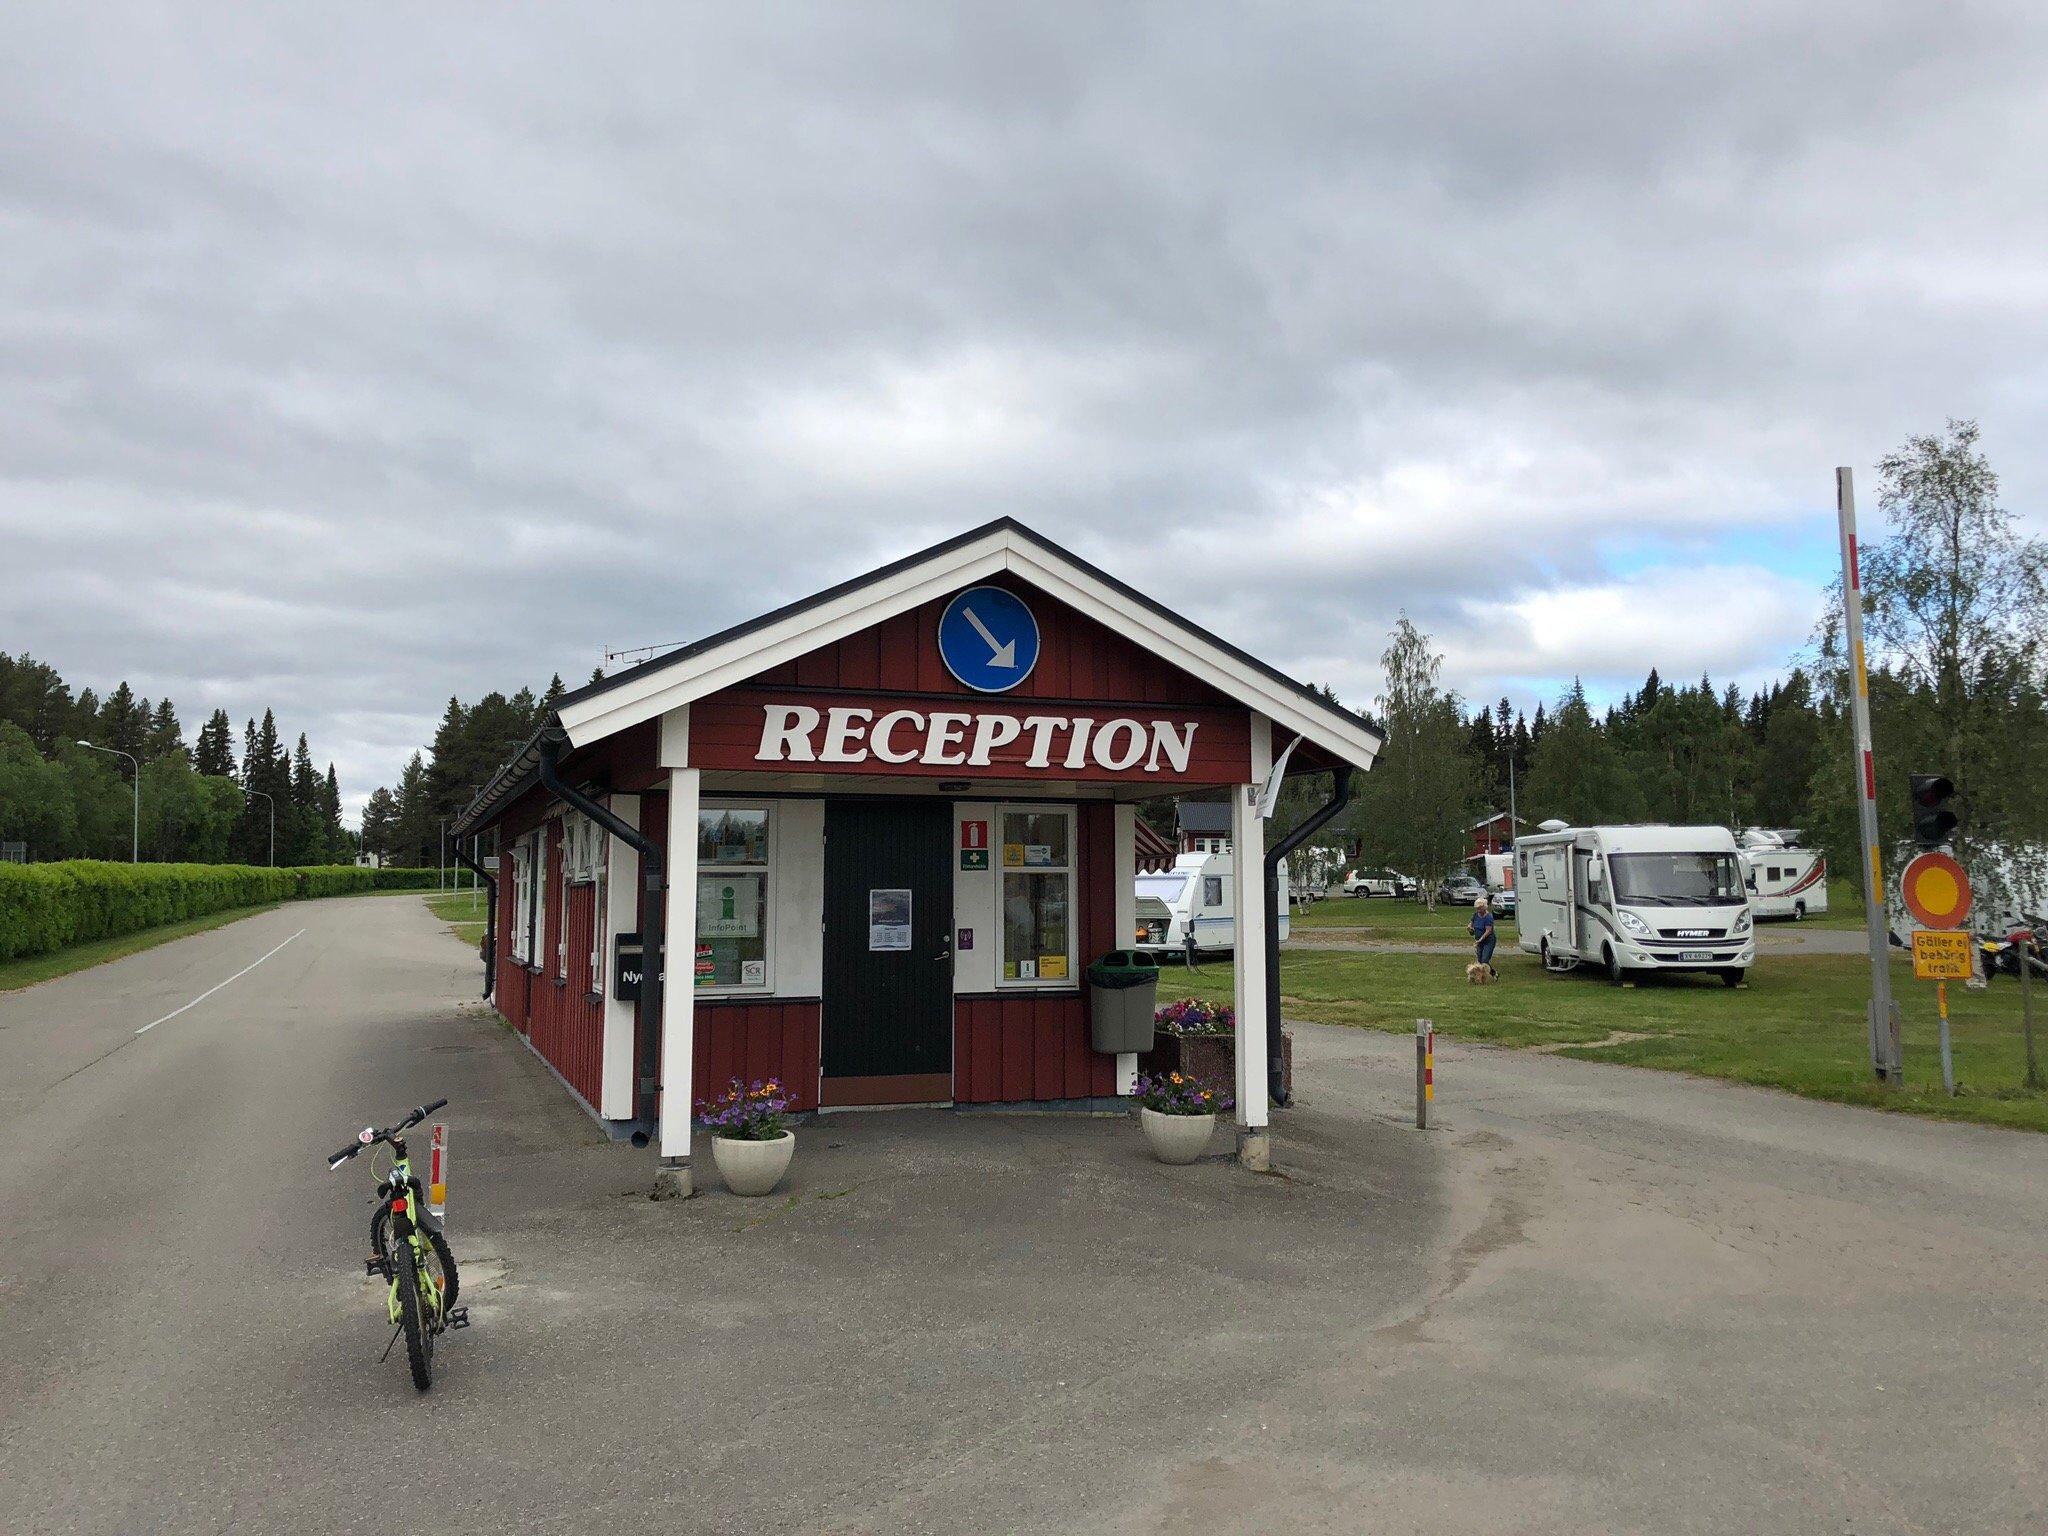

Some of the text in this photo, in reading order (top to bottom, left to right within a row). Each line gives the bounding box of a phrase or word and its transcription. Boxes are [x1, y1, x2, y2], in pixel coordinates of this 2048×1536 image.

[754, 704, 1199, 773] RECEPTION
[708, 923, 747, 932] InfoPoint
[1916, 935, 1953, 947] Gäller
[1920, 949, 1966, 963] behörig
[745, 967, 761, 975] SCR
[1928, 963, 1960, 973] trafik
